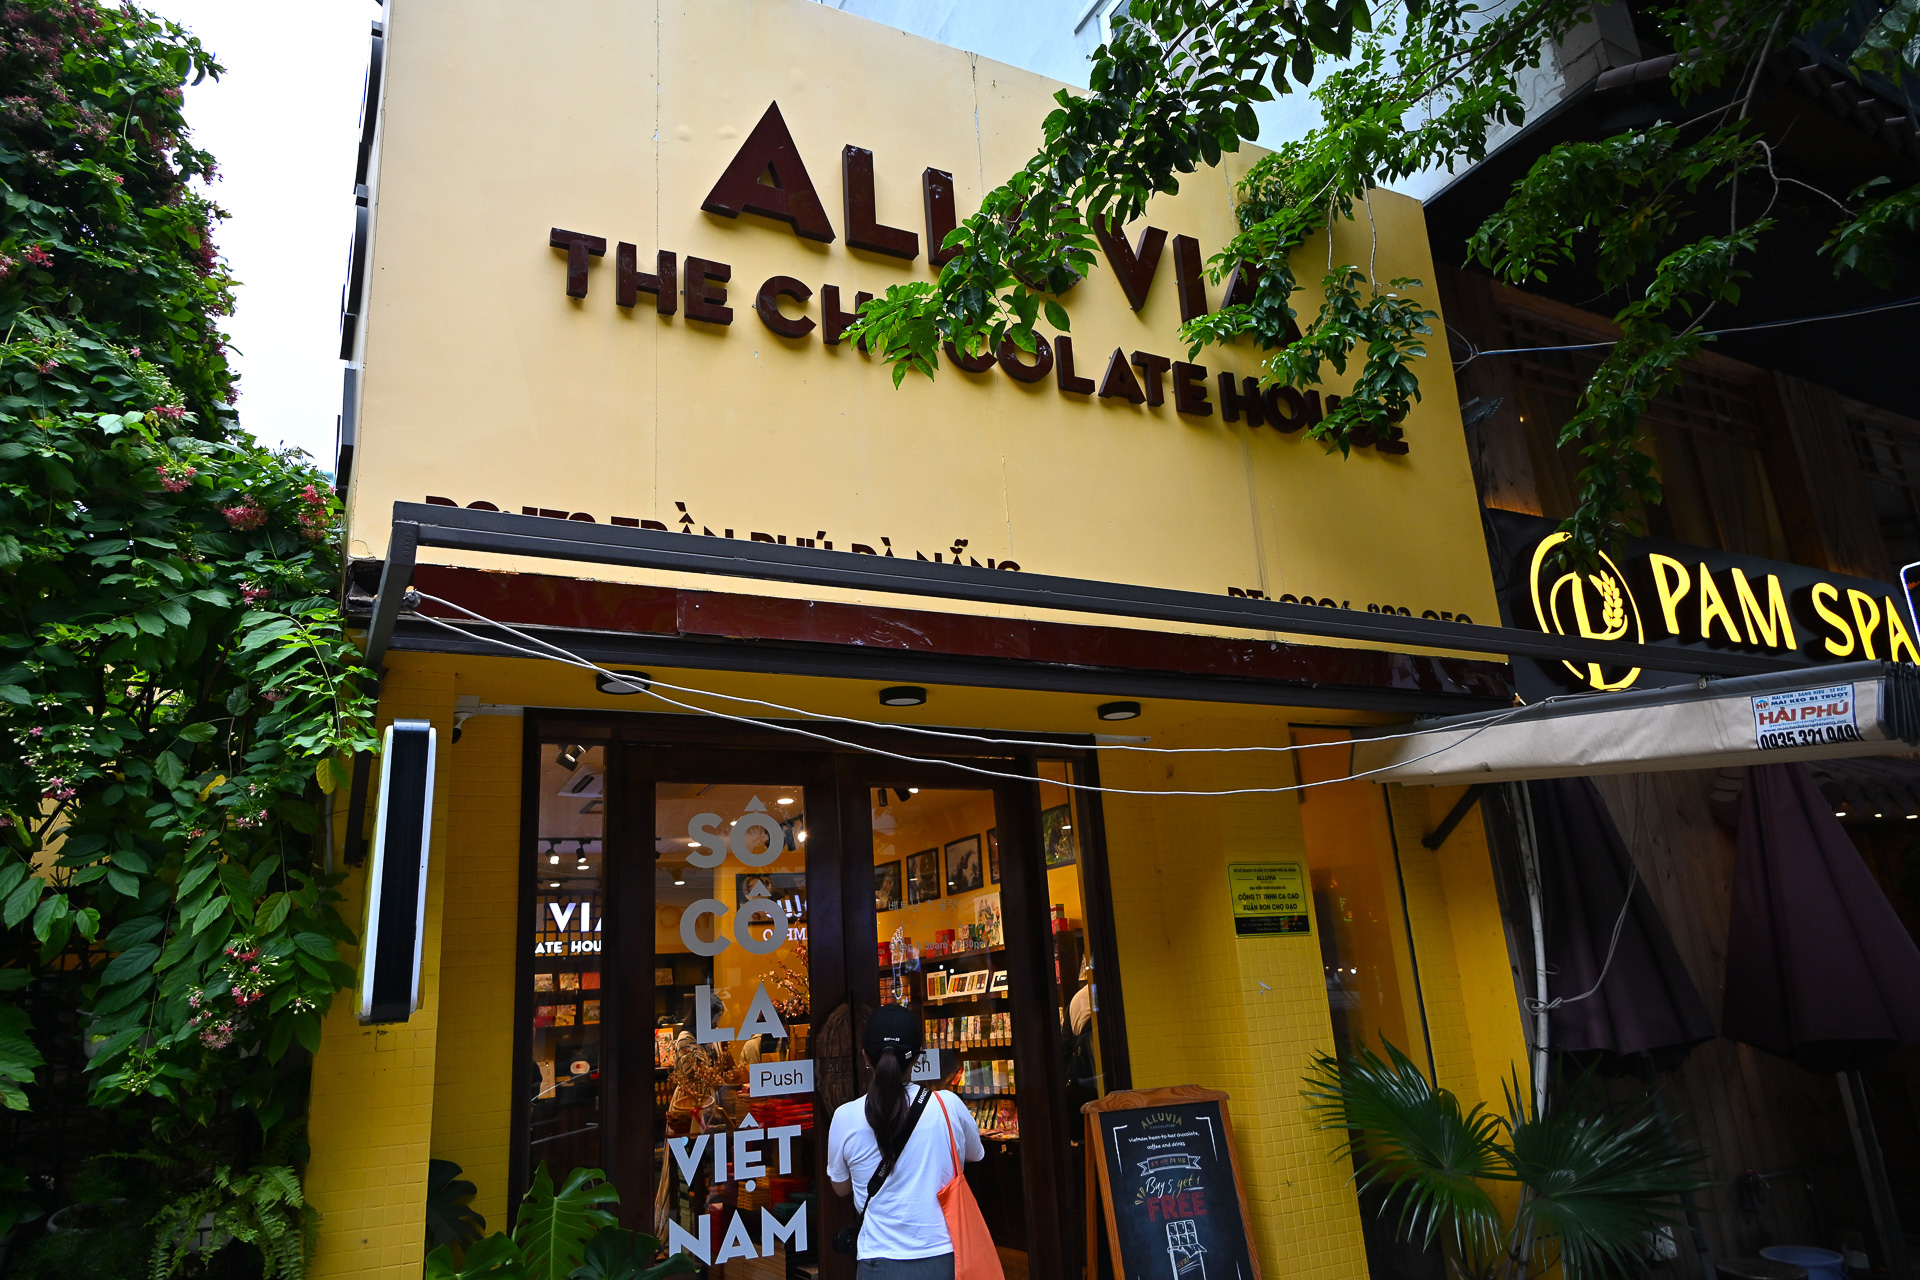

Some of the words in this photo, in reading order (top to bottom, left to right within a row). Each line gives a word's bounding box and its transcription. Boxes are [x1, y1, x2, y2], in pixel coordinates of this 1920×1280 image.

[549, 227, 733, 326] THE
[756, 275, 1213, 417] CHCOLATE
[1649, 553, 1797, 650] PAM
[1811, 582, 1920, 666] SPA
[1757, 702, 1769, 710] HP
[1758, 707, 1796, 725] HẢI
[1800, 700, 1849, 720] PHÚ
[685, 795, 785, 869] SÔ
[680, 879, 789, 956] CÔ
[695, 981, 788, 1044] LA
[760, 1069, 804, 1088] Push
[913, 1058, 931, 1074] sh
[1141, 1113, 1183, 1130] ALLUVIA
[667, 1112, 801, 1192] VIỆT
[1146, 1176, 1165, 1198] Buy
[1177, 1174, 1193, 1198] get
[1146, 1191, 1208, 1222] FREE
[669, 1200, 808, 1266] NAM
